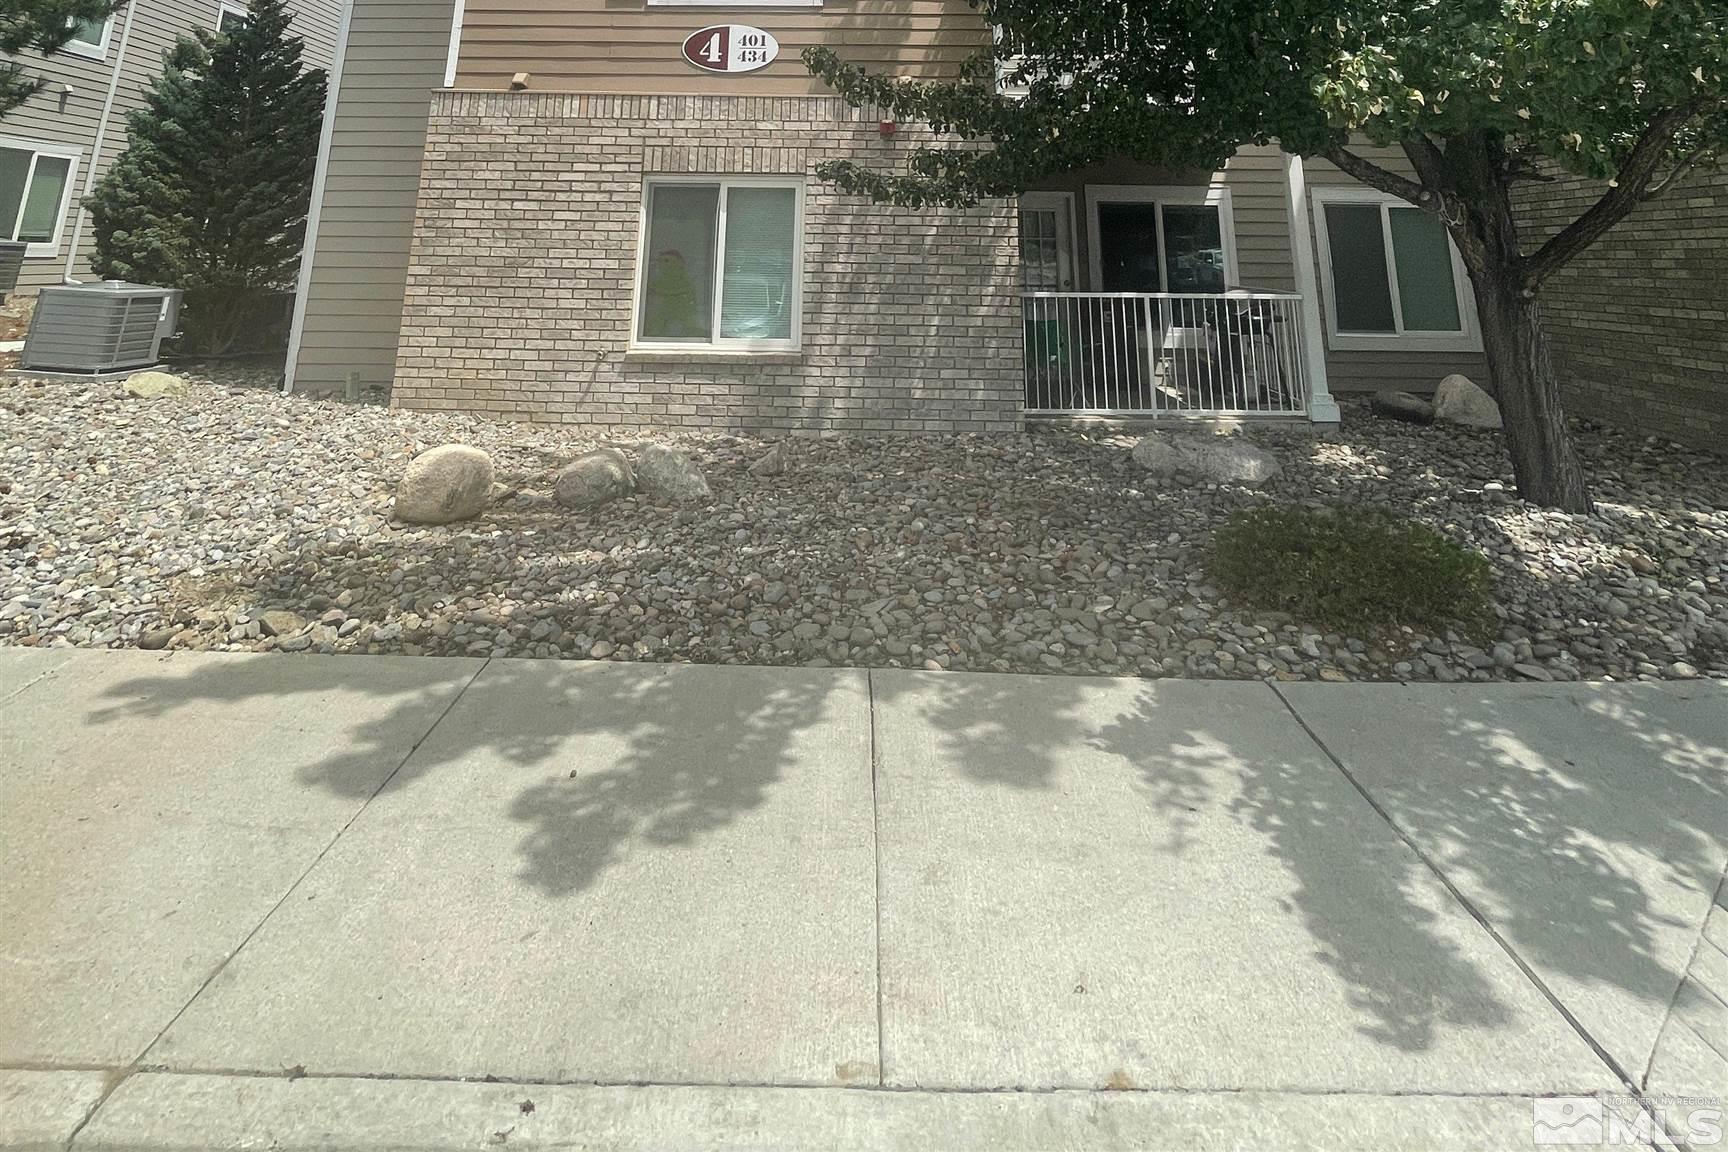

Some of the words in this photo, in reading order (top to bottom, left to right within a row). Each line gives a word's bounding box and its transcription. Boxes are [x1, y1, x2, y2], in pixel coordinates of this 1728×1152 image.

[699, 32, 722, 62] 4
[737, 34, 766, 47] 401
[737, 50, 767, 63] 434
